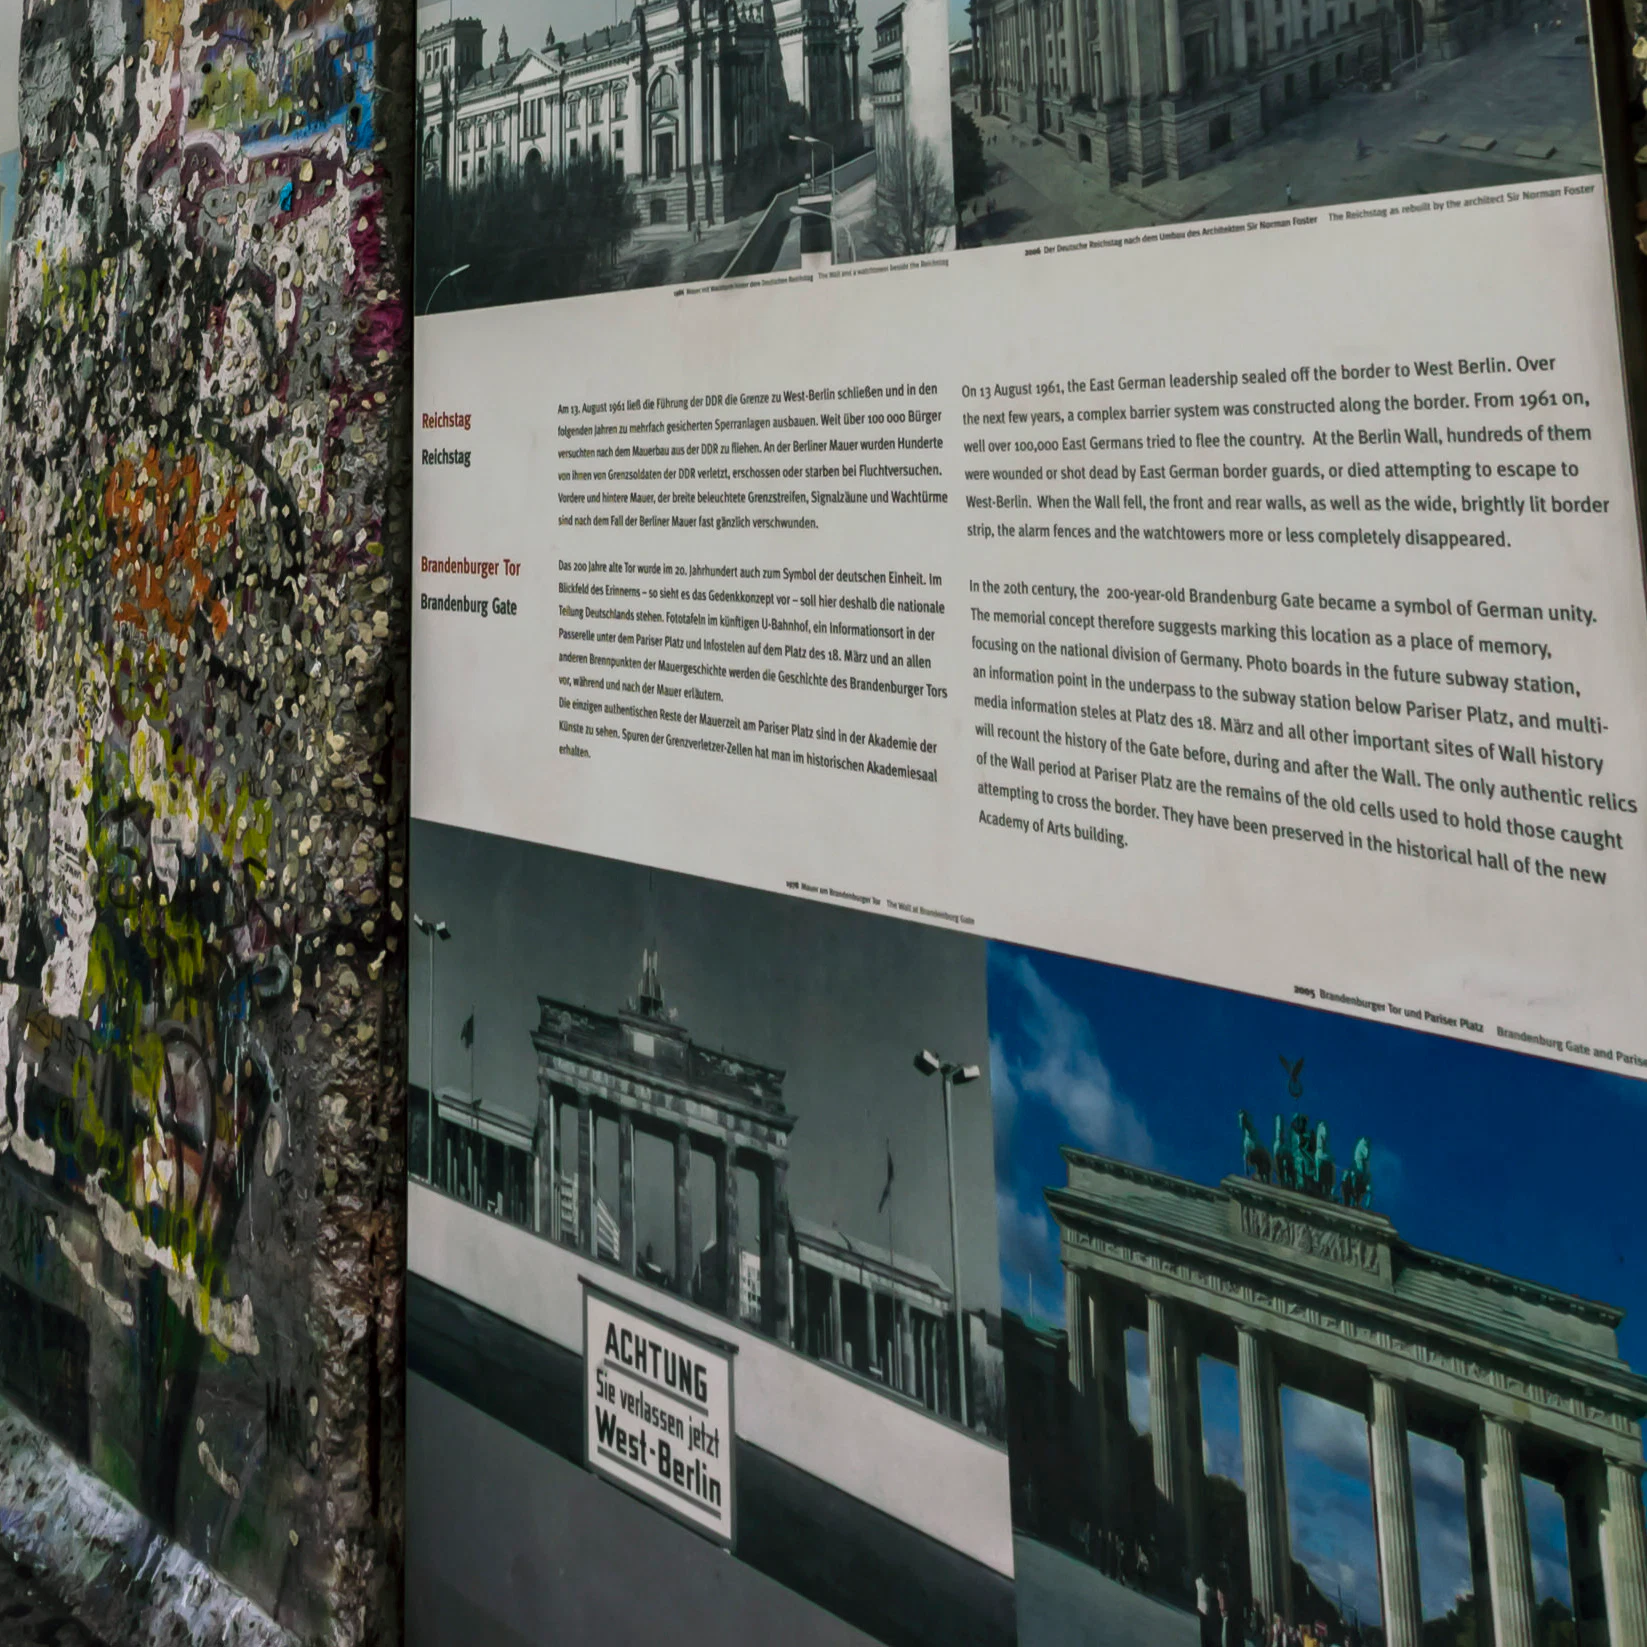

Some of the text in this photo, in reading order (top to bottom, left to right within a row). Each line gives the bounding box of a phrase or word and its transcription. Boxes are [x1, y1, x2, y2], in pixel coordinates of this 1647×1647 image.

[1328, 184, 1595, 222] The Reichstag as rebuilt by the architect Sir Norman Foster
[961, 355, 1557, 400] On 13 August 1961, the East German leadership sealed off the border to West Berlin. Over
[421, 411, 472, 431] Reichstag
[962, 389, 1591, 427] the next few years, a complex barrier system was constructed along the border. From 1961 on,
[421, 447, 472, 469] Reichstag
[557, 491, 586, 504] Vordere
[586, 491, 601, 504] und
[601, 491, 629, 504] hintere
[657, 491, 672, 504] der
[671, 490, 696, 504] breite
[696, 490, 747, 504] beleuchtete
[810, 489, 869, 507] Signalzäune
[869, 489, 890, 504] und
[890, 489, 949, 504] Wachtürme
[965, 493, 1610, 517] West-Berlin. When the Wall fell, the front and rear walls, as well as the wide, brightly lit border
[421, 555, 522, 580] Brandenburger Tor
[420, 592, 518, 619] Brandenburg Gate
[969, 579, 1598, 628] In the 20th century, the 200-year-old Brandenburg Gate became a symbol of German unity.
[1319, 988, 1386, 1013] Brandenburger
[1387, 1002, 1403, 1016] Tor
[1403, 1008, 1423, 1021] und
[1423, 1010, 1458, 1028] Pariser
[1459, 1017, 1484, 1034] Platz
[1496, 1025, 1564, 1053] Brandenburg
[1565, 1040, 1591, 1056] Gate
[1593, 1048, 1614, 1061] and
[605, 1322, 708, 1403] ACHTUNG
[596, 1368, 720, 1459] Sie verlassen jetzt
[595, 1405, 722, 1507] West-Berlin
